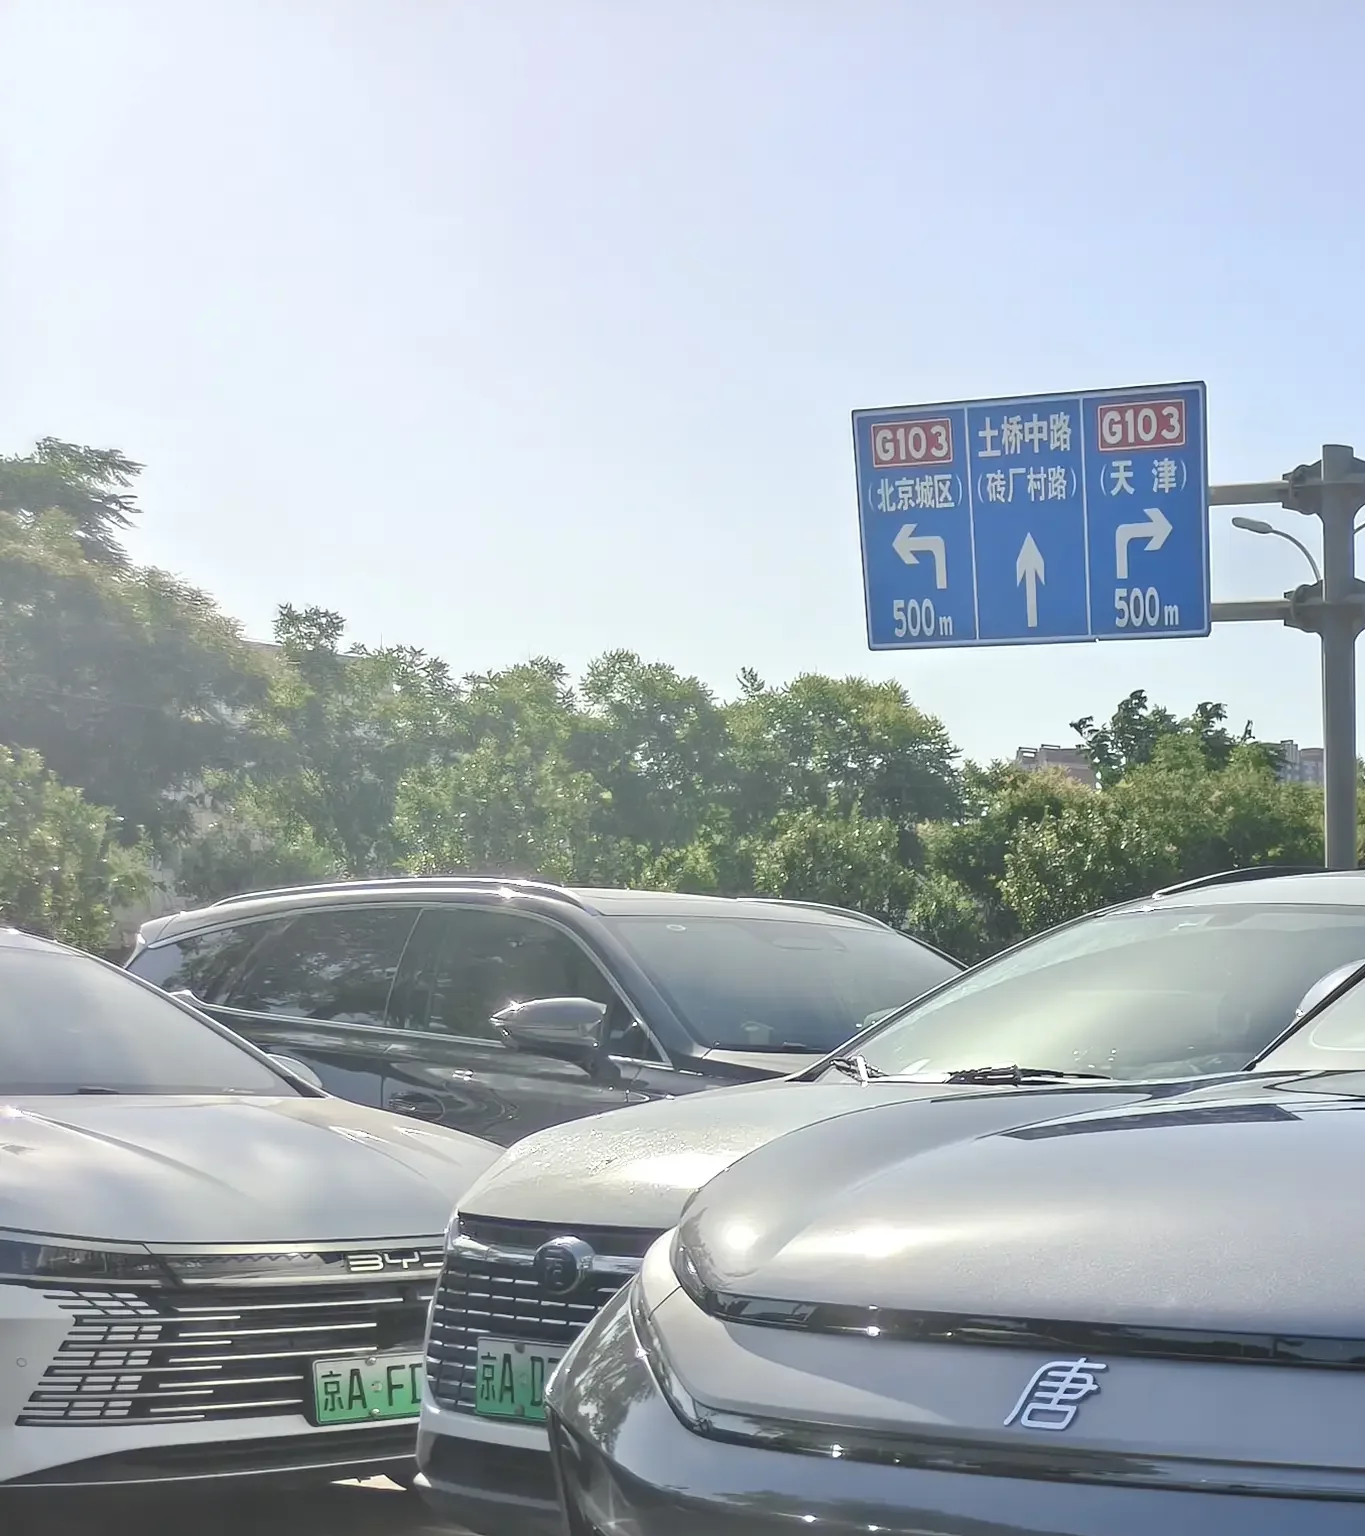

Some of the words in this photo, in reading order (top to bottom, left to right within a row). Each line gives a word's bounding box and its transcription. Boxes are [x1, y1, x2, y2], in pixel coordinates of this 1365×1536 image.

[875, 425, 950, 462] G103
[978, 412, 1072, 457] 土桥中路
[1102, 405, 1181, 446] G103
[1003, 1356, 1107, 1430] 唐
